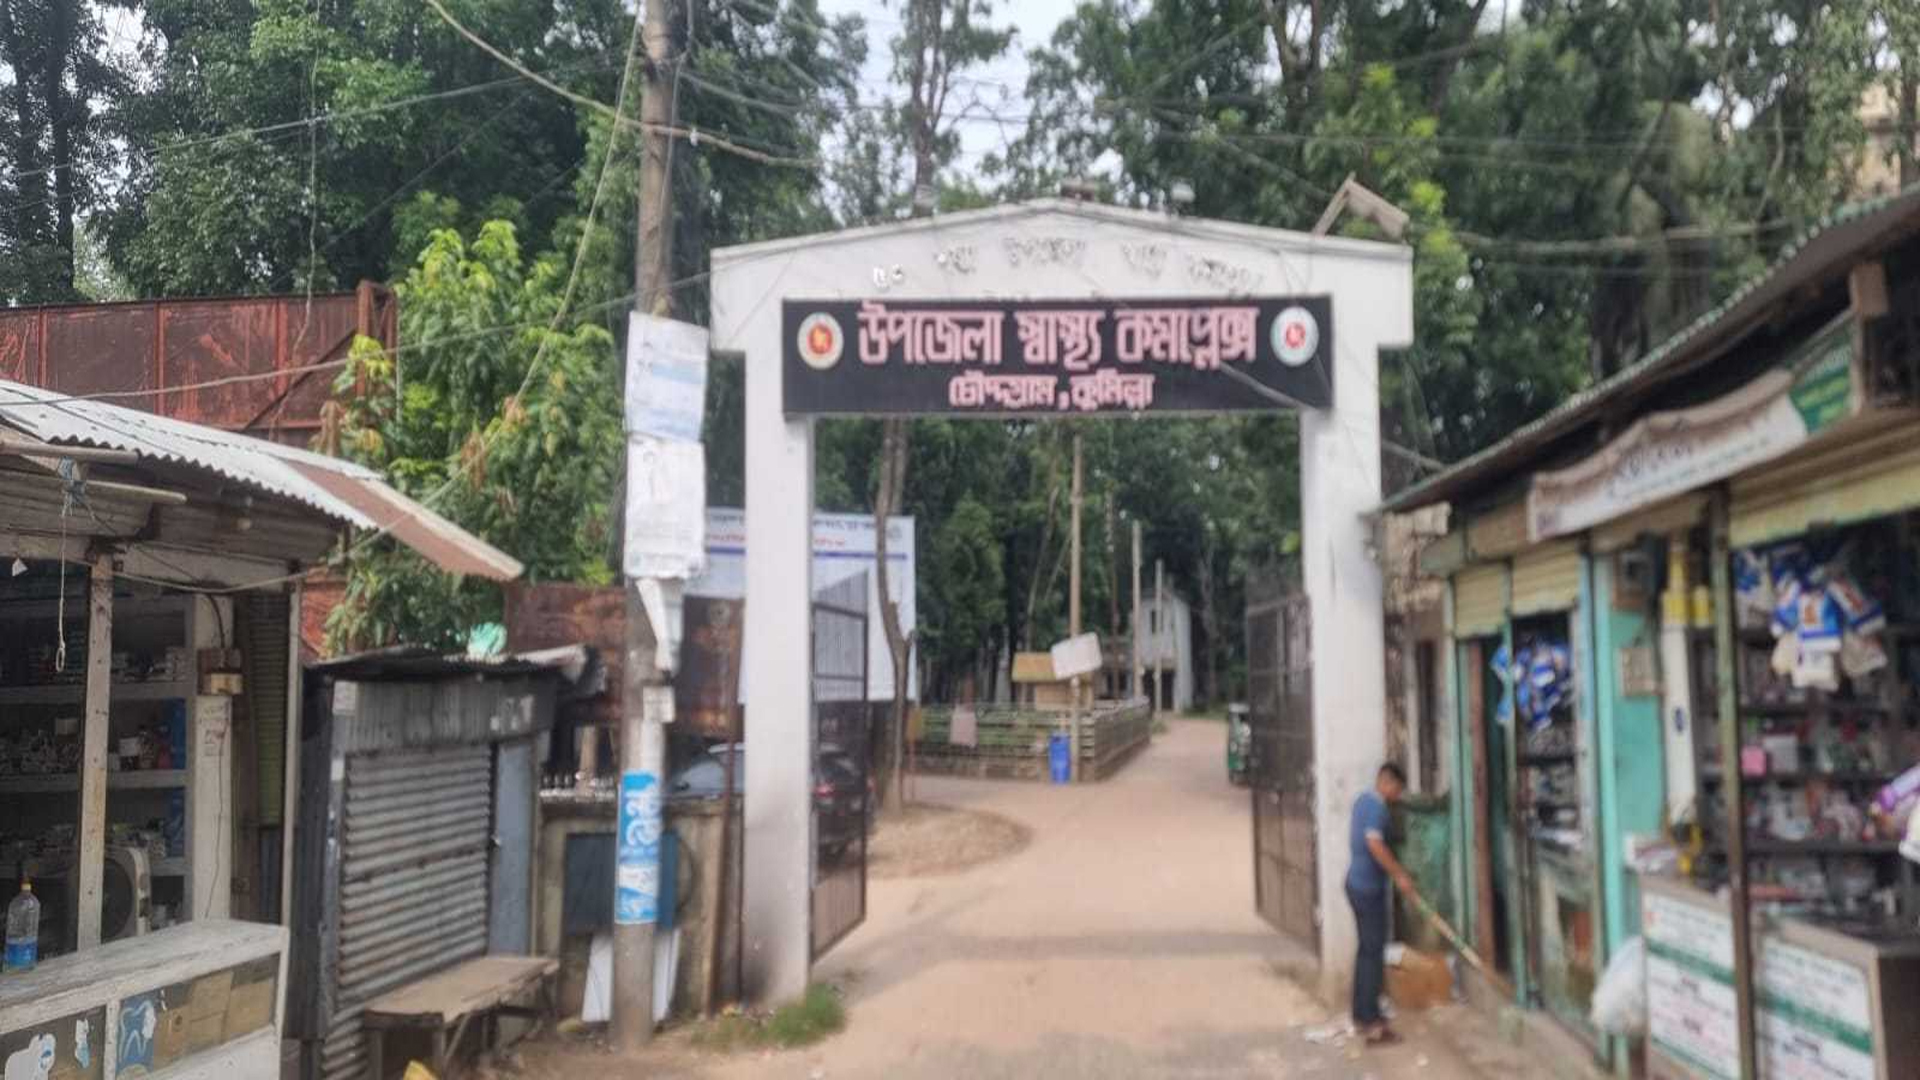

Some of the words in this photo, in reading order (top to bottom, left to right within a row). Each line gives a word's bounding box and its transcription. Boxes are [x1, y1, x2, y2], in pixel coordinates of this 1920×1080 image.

[857, 300, 1005, 364] উপজেলা
[1013, 310, 1105, 370] স্বাস্থ্য
[1113, 307, 1260, 370] কমপ্লেক্স
